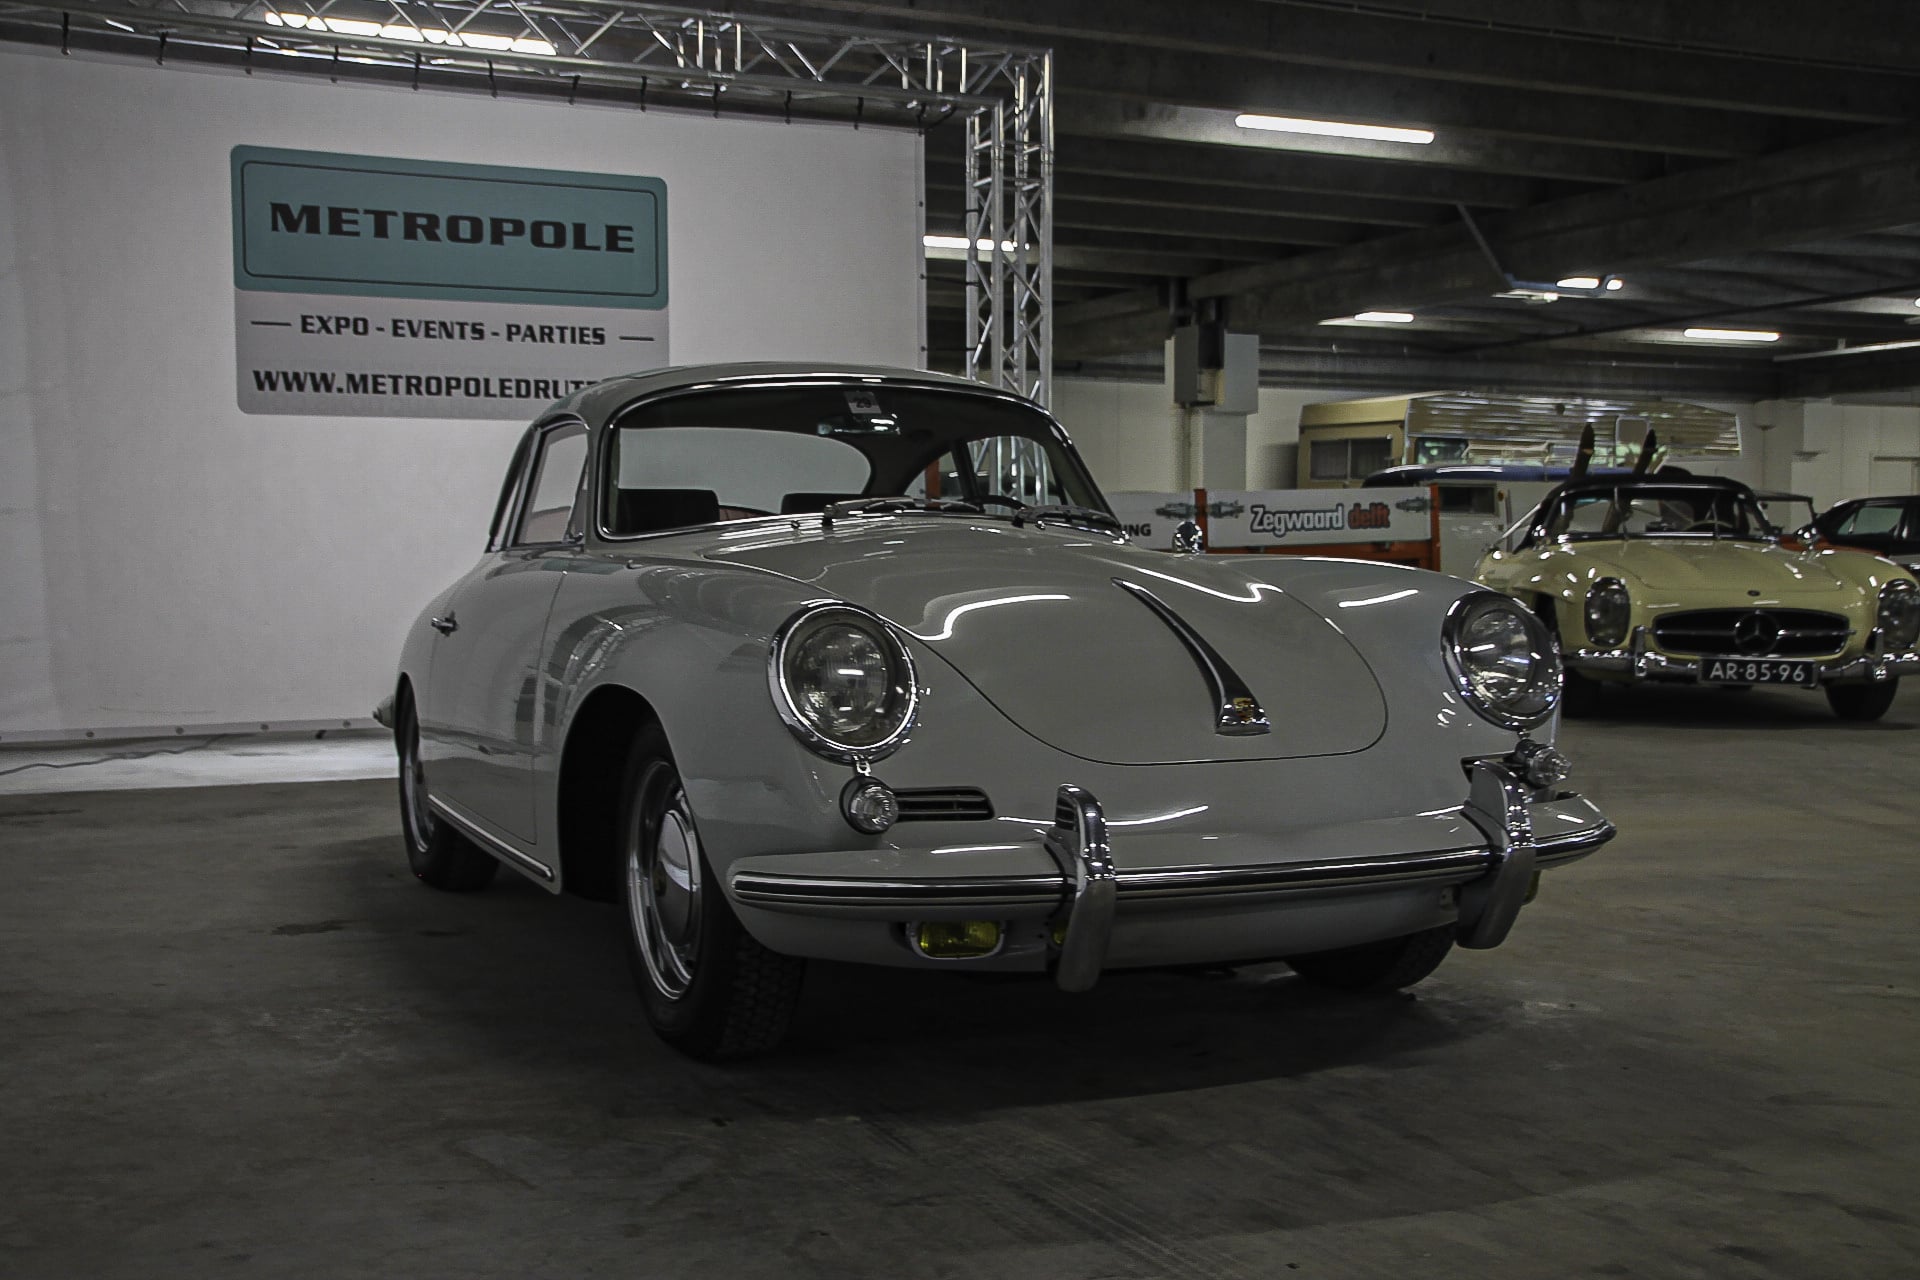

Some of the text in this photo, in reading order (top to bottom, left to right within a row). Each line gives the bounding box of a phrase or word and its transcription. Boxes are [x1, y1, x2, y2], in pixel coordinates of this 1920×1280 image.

[269, 202, 635, 253] METROPOLE
[300, 314, 369, 336] EXPO
[391, 318, 486, 341] EVENTS
[505, 323, 606, 346] PARTIES
[252, 370, 599, 400] WWW.METROPOLEDRUT
[1250, 502, 1391, 538] Zegwaard delft
